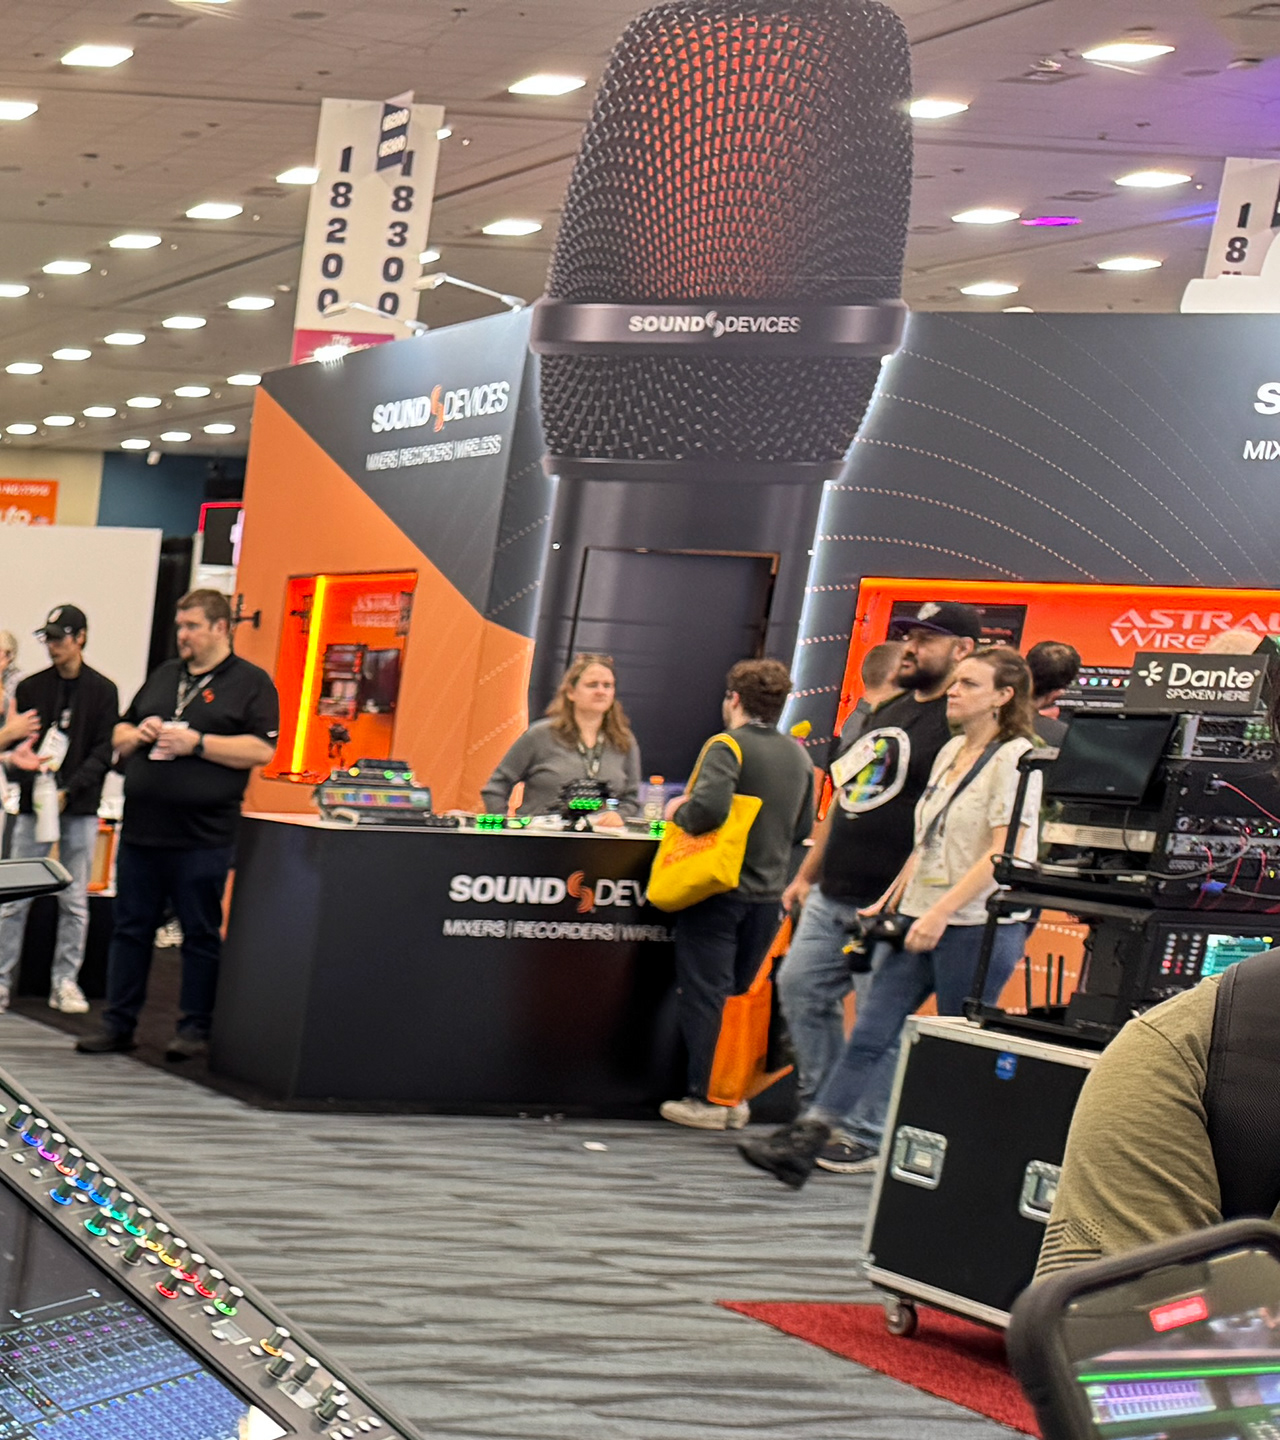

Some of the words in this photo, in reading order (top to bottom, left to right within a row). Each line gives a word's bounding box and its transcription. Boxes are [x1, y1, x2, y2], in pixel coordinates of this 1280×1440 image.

[317, 146, 353, 318] 18200
[379, 150, 414, 316] 18300
[628, 315, 705, 332] SOUND
[724, 316, 802, 333] DEVICES
[371, 396, 431, 433] SOUND
[443, 381, 510, 422] DEVICES
[1168, 662, 1255, 690] Dante
[1166, 688, 1217, 701] SPOKEN
[1217, 690, 1252, 703] HERE
[449, 875, 566, 905] SOUND
[442, 919, 506, 938] MIXERS
[513, 920, 614, 941] RECORDERS
